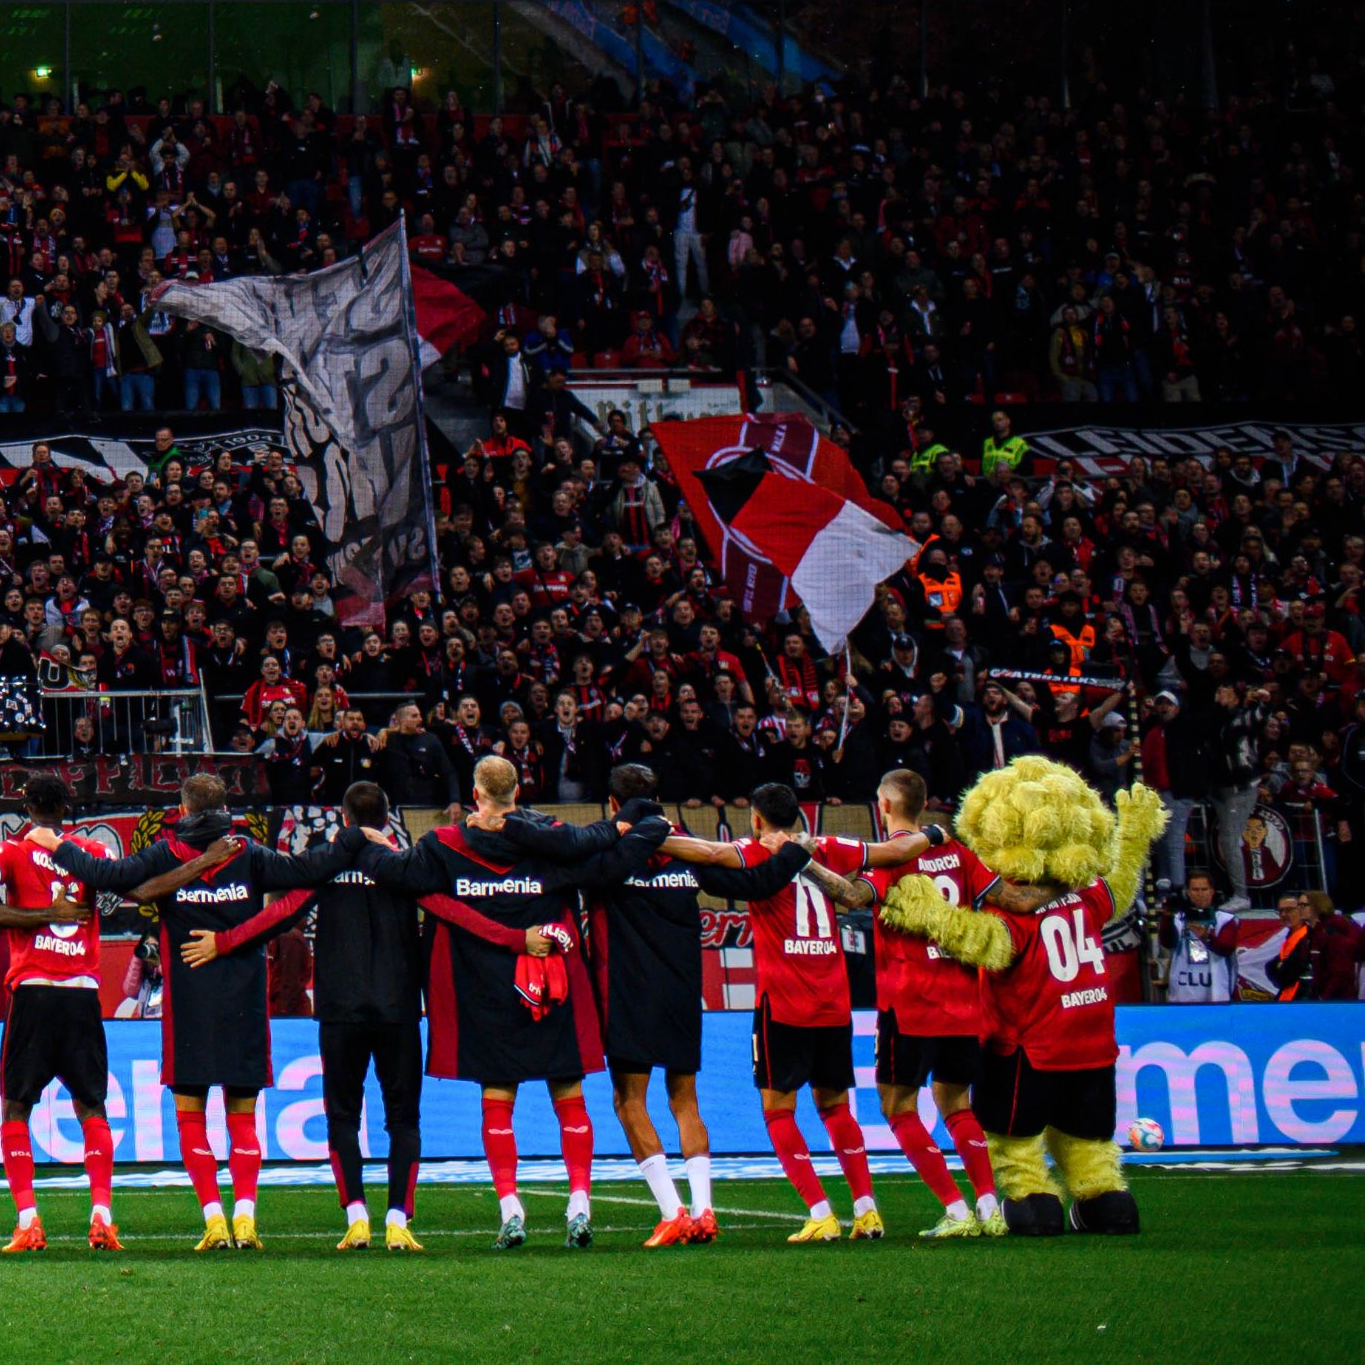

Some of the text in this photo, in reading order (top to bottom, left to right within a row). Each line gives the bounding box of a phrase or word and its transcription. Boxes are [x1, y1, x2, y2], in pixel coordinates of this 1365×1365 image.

[175, 882, 249, 903] Barmenia
[456, 876, 542, 897] Barmenia
[792, 871, 832, 939] 11
[34, 935, 86, 957] BAYER04
[784, 938, 838, 955] BAYER04
[1040, 909, 1105, 983] 04
[1060, 988, 1109, 1009] BAYER04
